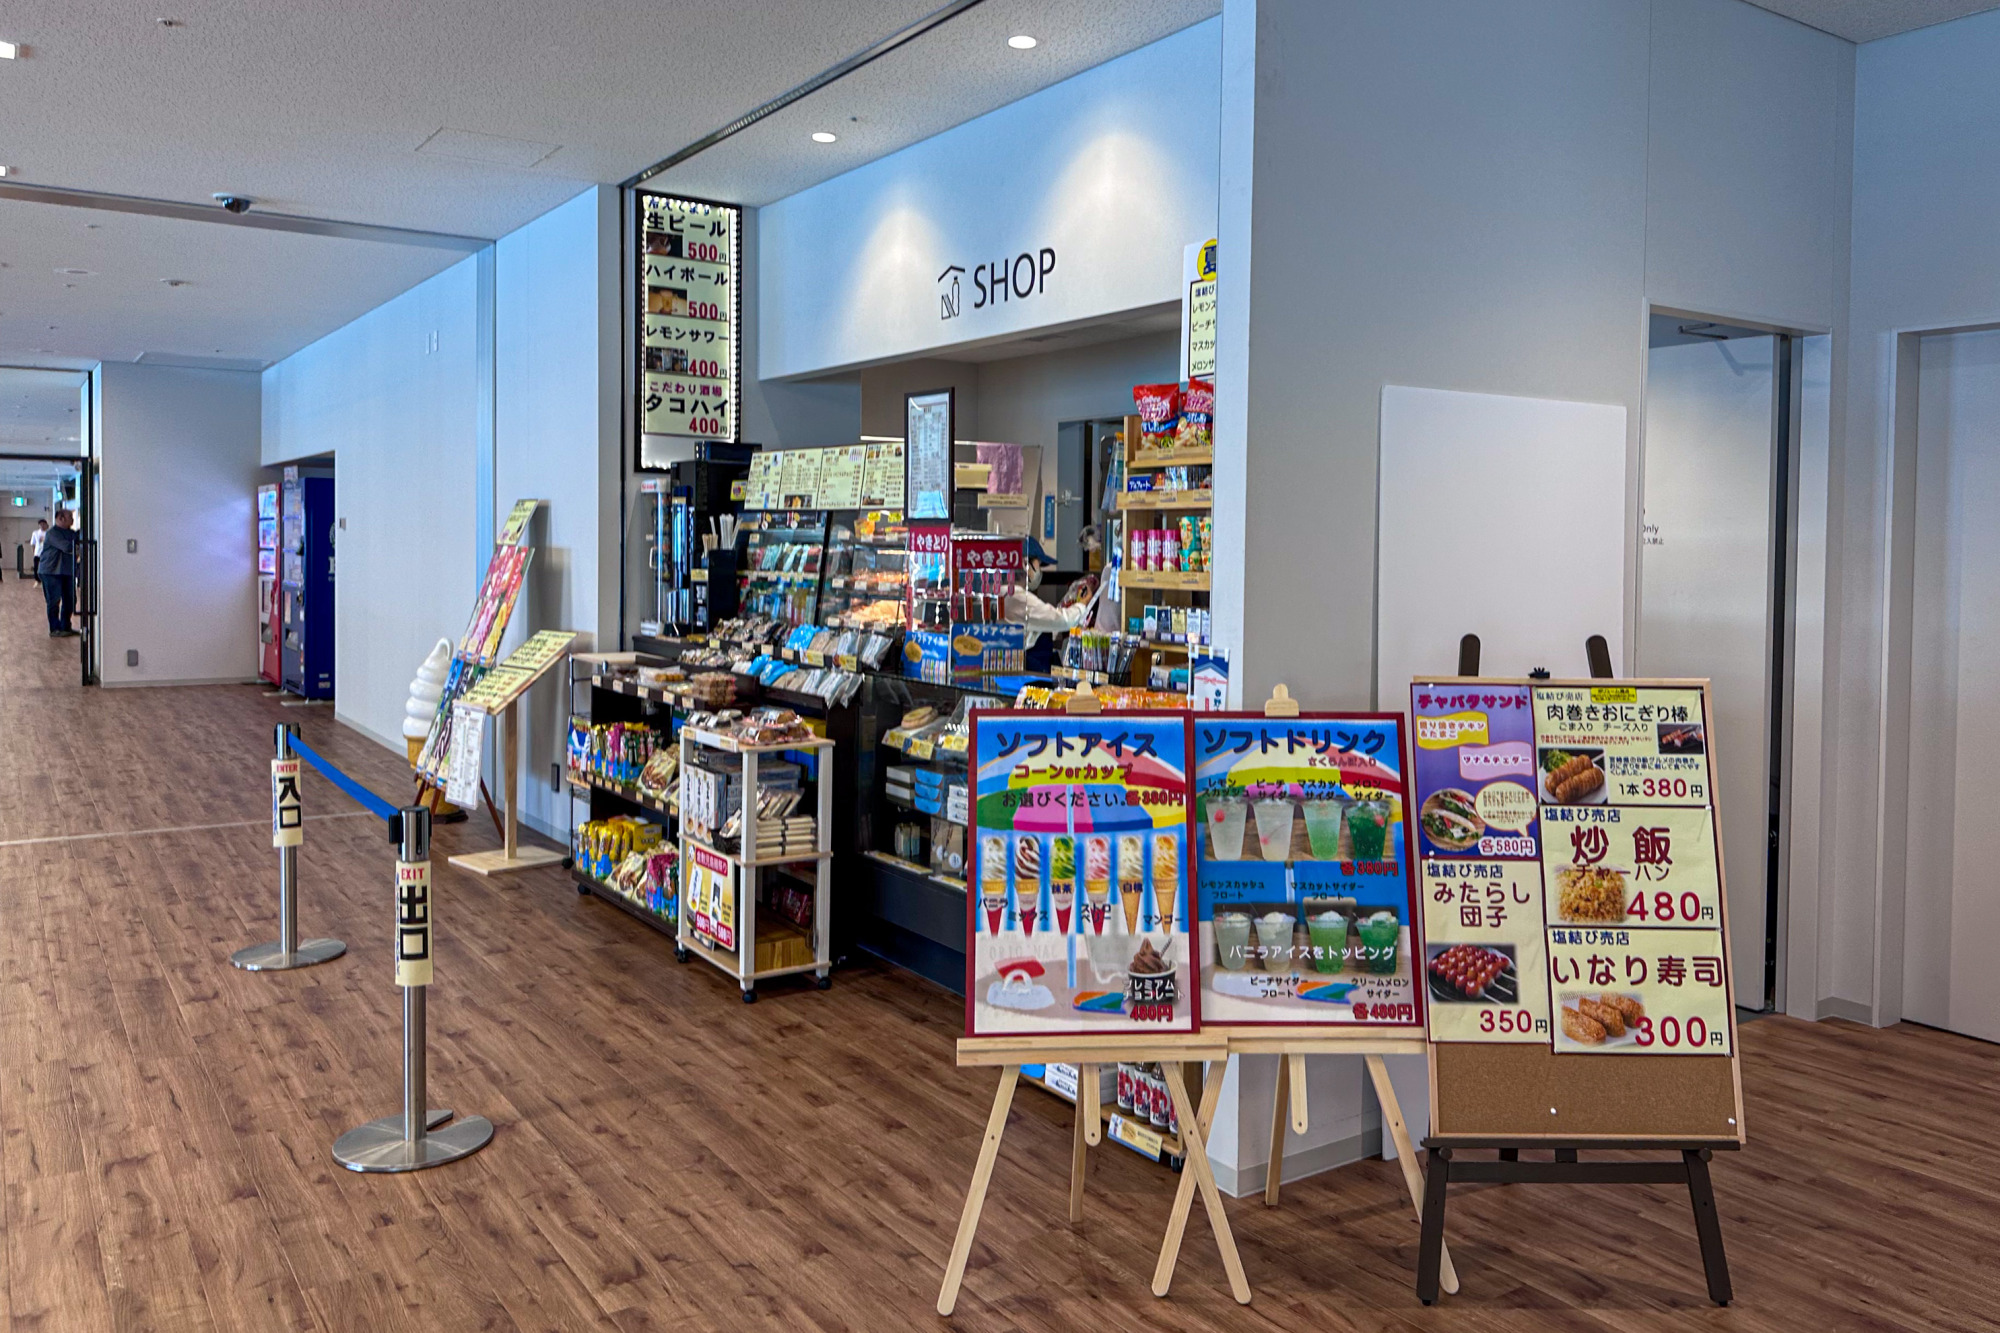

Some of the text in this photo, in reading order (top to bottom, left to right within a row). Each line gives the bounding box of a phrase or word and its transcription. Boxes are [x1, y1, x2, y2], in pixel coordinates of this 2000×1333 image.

[647, 210, 726, 238] 生ビール
[688, 241, 727, 263] 500円
[646, 264, 728, 286] ハイボール
[974, 247, 1056, 309] SHOP
[688, 301, 728, 322] 500円
[646, 325, 729, 343] レモンサワー
[689, 359, 728, 378] 400円
[650, 381, 722, 398] こだわり酒場
[646, 393, 728, 418] タコハイ
[689, 417, 728, 435] 400円
[917, 534, 947, 551] やきとり
[967, 549, 1019, 567] やきとり
[1418, 694, 1528, 710] チャバタサンド
[1536, 691, 1583, 701] 塩結び売店
[1547, 704, 1688, 723] 肉巻きおにぎり棒
[1559, 722, 1648, 732] ごま入り チーズ入り
[997, 731, 1158, 757] ソフトアイス
[1203, 728, 1386, 754] ソフトドリンク
[277, 764, 298, 772] ENTER
[1463, 756, 1530, 765] ツナ&チェダー
[1014, 763, 1133, 779] コーンorカップ
[1208, 779, 1236, 787] レモン
[1256, 779, 1284, 788] ピーチ
[1297, 779, 1347, 788] マスカット
[1353, 779, 1381, 789] メロン
[1259, 789, 1298, 799] サイダー
[1305, 790, 1345, 800] サイダー
[1354, 790, 1394, 800] サイダー
[279, 776, 302, 828] 入口
[1544, 808, 1621, 822] 塩結び売店
[1481, 838, 1534, 854] 各580円
[401, 868, 424, 880] EXIT
[1341, 861, 1398, 876] 各380円
[1427, 864, 1504, 878] 塩結び売店
[1576, 865, 1669, 881] チャーハン
[1051, 882, 1073, 894] 抹茶
[1123, 882, 1143, 894] 白桃
[1201, 881, 1265, 889] レモンスカッシュ
[1291, 881, 1365, 890] マスカットサイダー
[1434, 881, 1531, 904] みたらし
[1212, 891, 1244, 899] フロート
[1311, 892, 1344, 900] フロート
[978, 897, 1009, 909] バニラ
[1081, 903, 1111, 913] ストロ
[1627, 892, 1714, 921] 480円
[400, 885, 428, 960] 出口
[1008, 911, 1048, 921] ミックス
[1081, 913, 1111, 923] ベリー
[1143, 914, 1183, 925] マンゴー
[1460, 905, 1508, 927] 団子
[1553, 931, 1630, 946] 塩結び売店
[1229, 945, 1395, 960] バニラアイスをトッピング
[1553, 954, 1723, 987] いなり寿司
[1122, 979, 1175, 990] プレミアム
[1250, 976, 1308, 986] ピーチサイダー
[1351, 977, 1410, 987] クリームメロン
[1261, 990, 1294, 998] フロート
[1366, 990, 1400, 998] サイダー
[1130, 1004, 1174, 1022] 480円
[1352, 1003, 1413, 1020] 各480円
[1480, 1010, 1548, 1033] 350円
[1635, 1016, 1724, 1048] 300円
